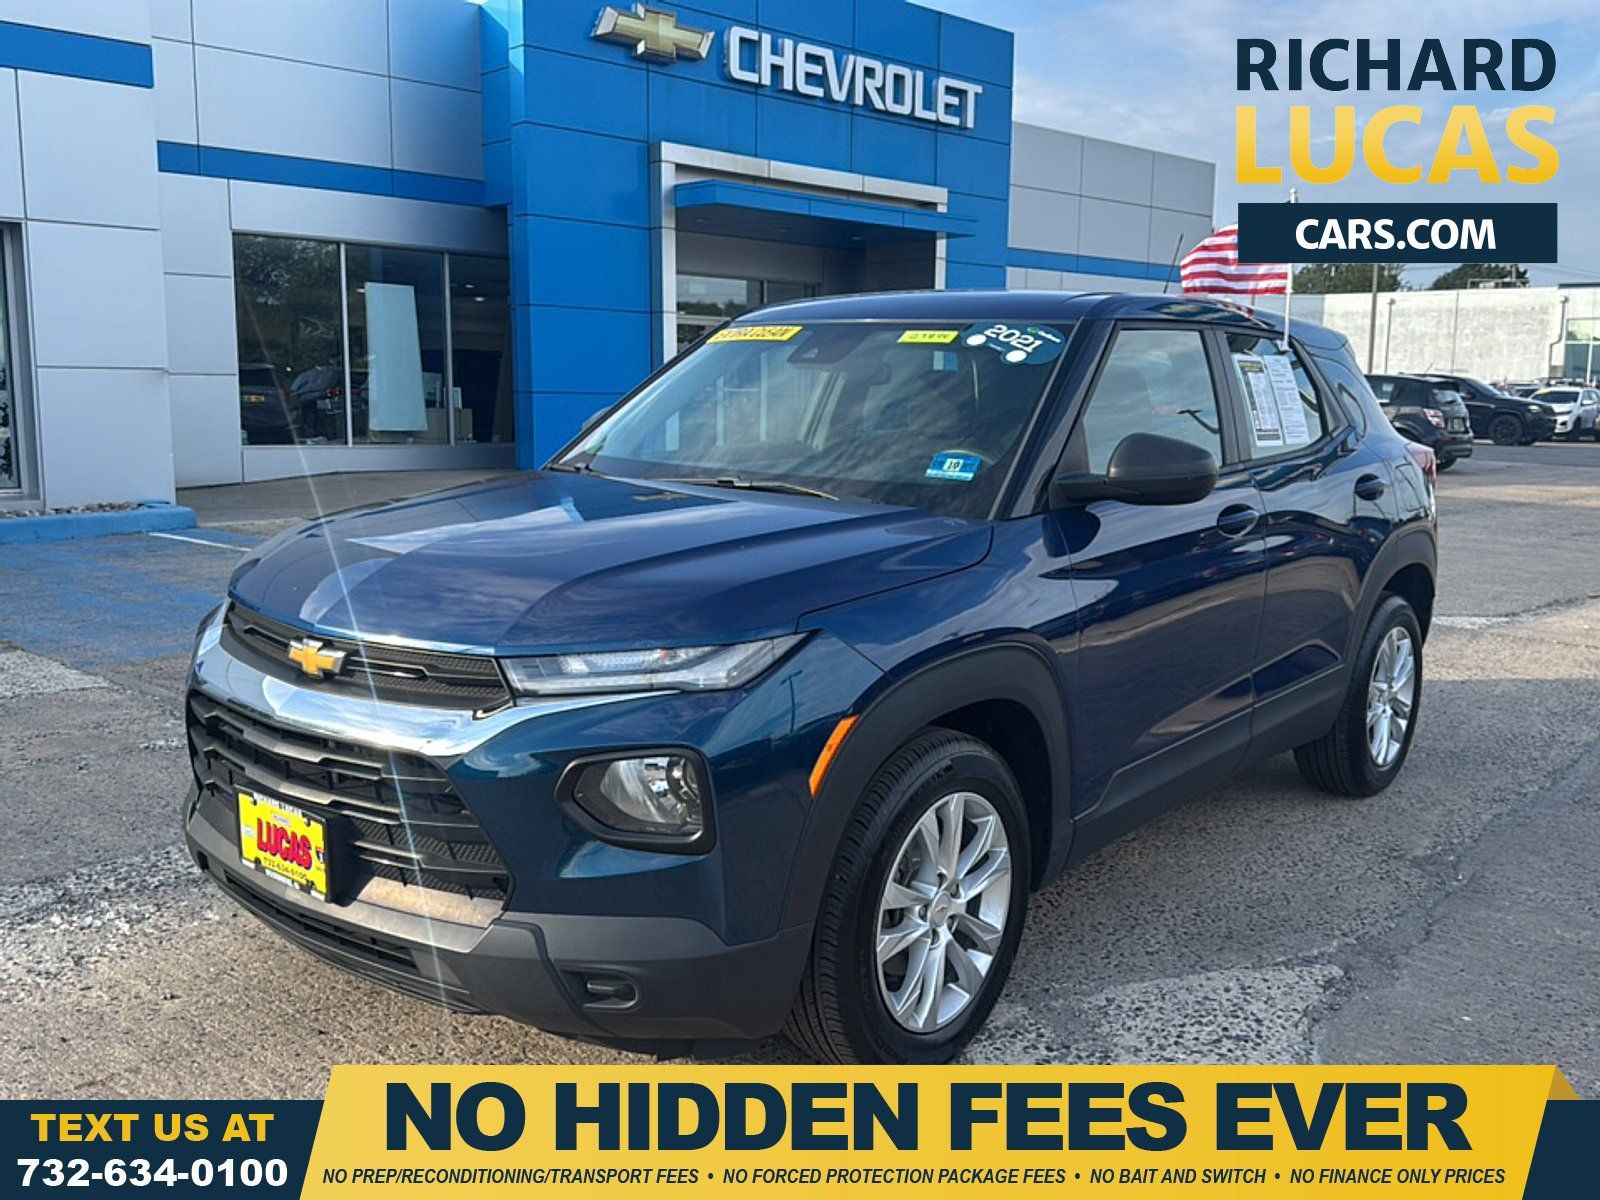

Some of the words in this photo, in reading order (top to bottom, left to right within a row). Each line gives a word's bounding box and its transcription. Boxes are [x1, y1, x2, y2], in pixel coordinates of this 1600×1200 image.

[725, 25, 982, 129] CHEVROLET
[984, 324, 1043, 353] 2021
[256, 817, 312, 870] LUCAS
